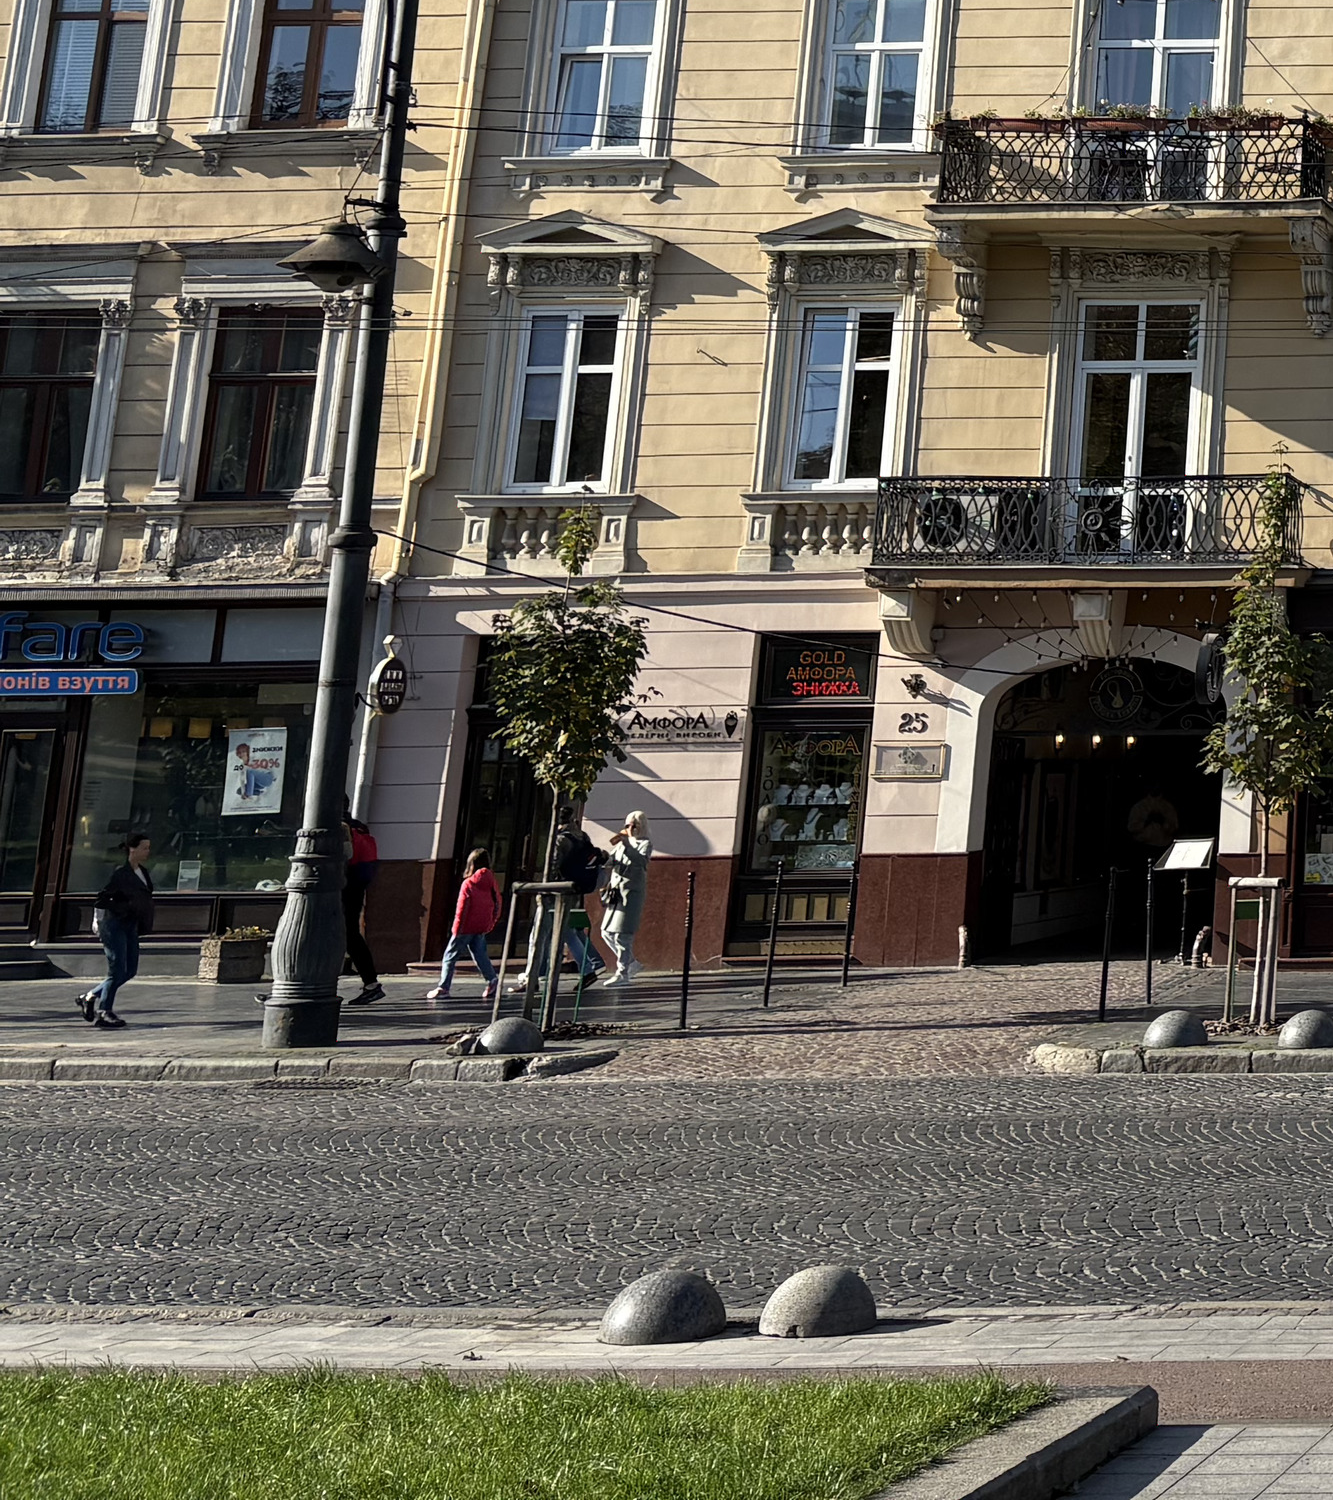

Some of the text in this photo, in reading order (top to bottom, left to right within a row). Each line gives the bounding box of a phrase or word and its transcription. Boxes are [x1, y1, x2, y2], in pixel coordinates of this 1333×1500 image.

[800, 651, 846, 664] GOLD
[786, 667, 856, 680] АМФОРА
[0, 673, 129, 693] онів взуття
[791, 681, 861, 695] ЗНИЖКА
[627, 709, 709, 730] АМФОРА
[898, 713, 929, 734] 25
